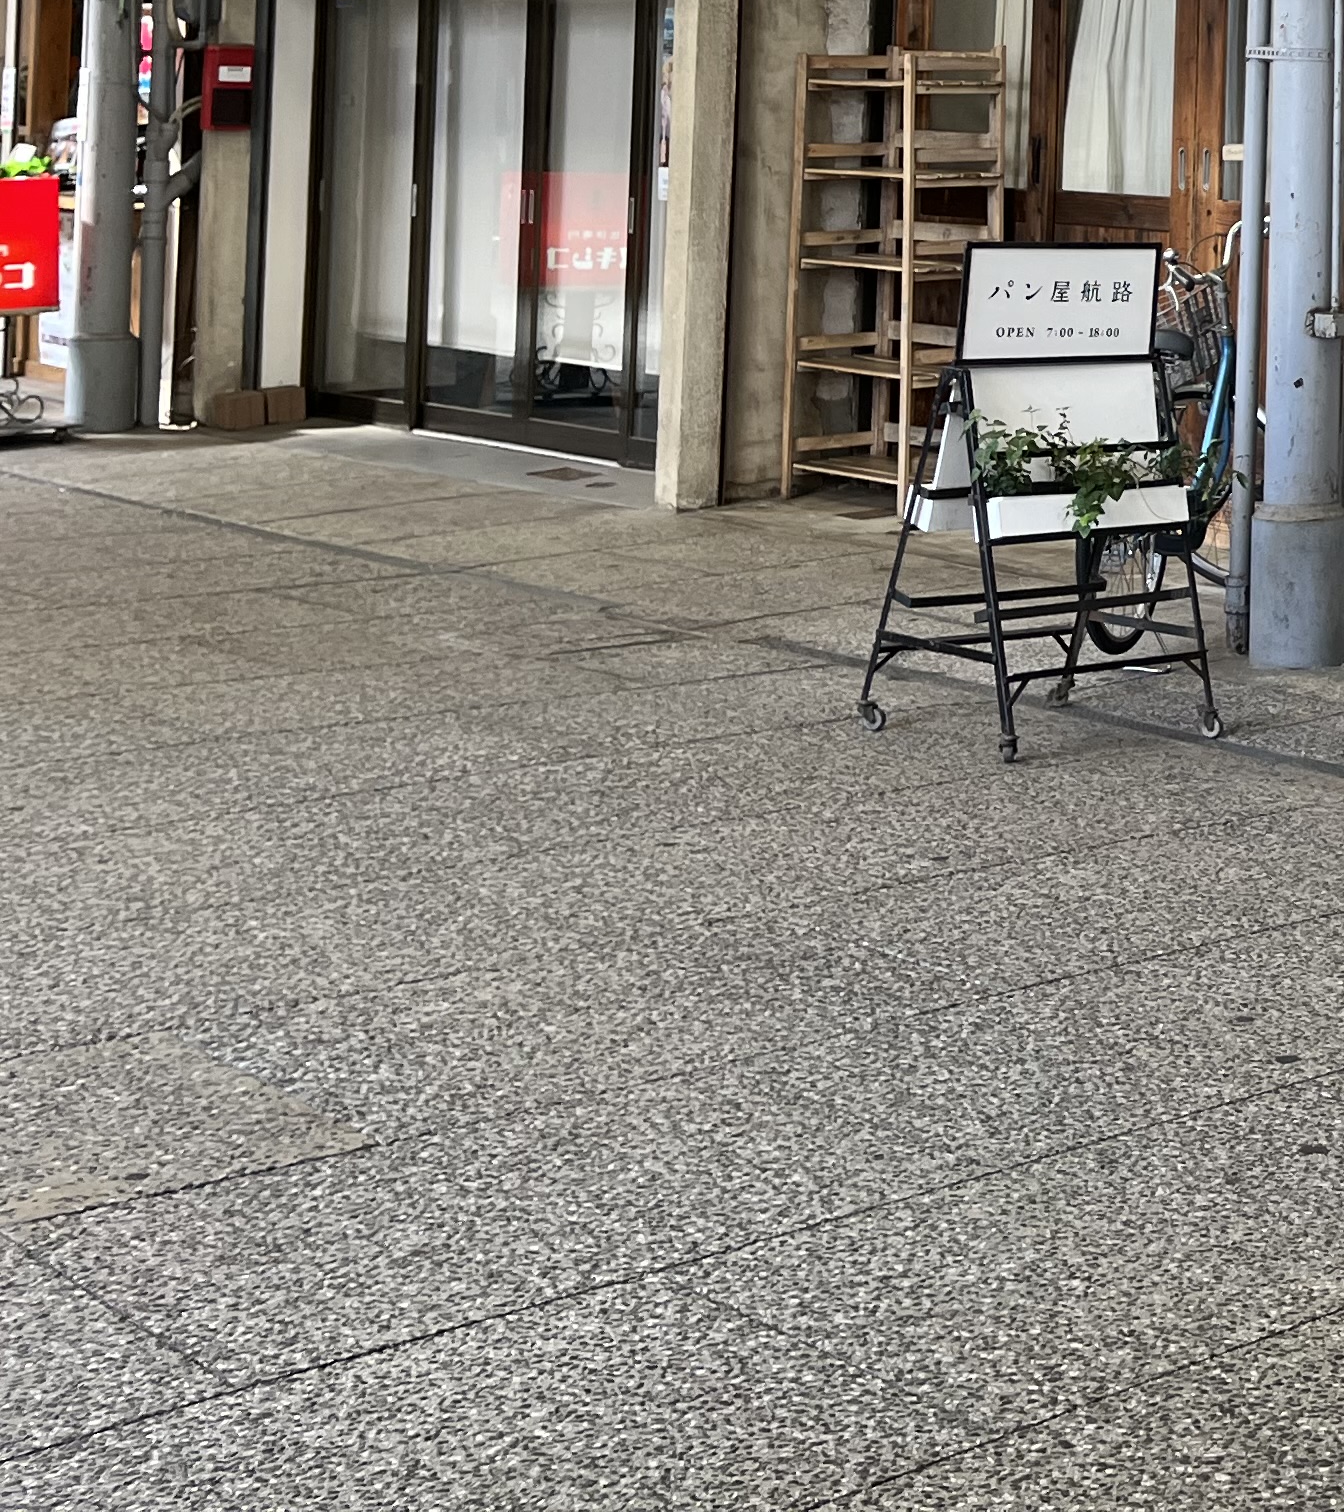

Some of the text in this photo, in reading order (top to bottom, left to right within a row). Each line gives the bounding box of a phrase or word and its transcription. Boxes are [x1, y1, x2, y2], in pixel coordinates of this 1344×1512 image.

[988, 279, 1133, 303] パン屋航路
[996, 327, 1035, 338] OPEN
[1046, 327, 1073, 338] 7:00
[1088, 327, 1120, 338] 18:00
